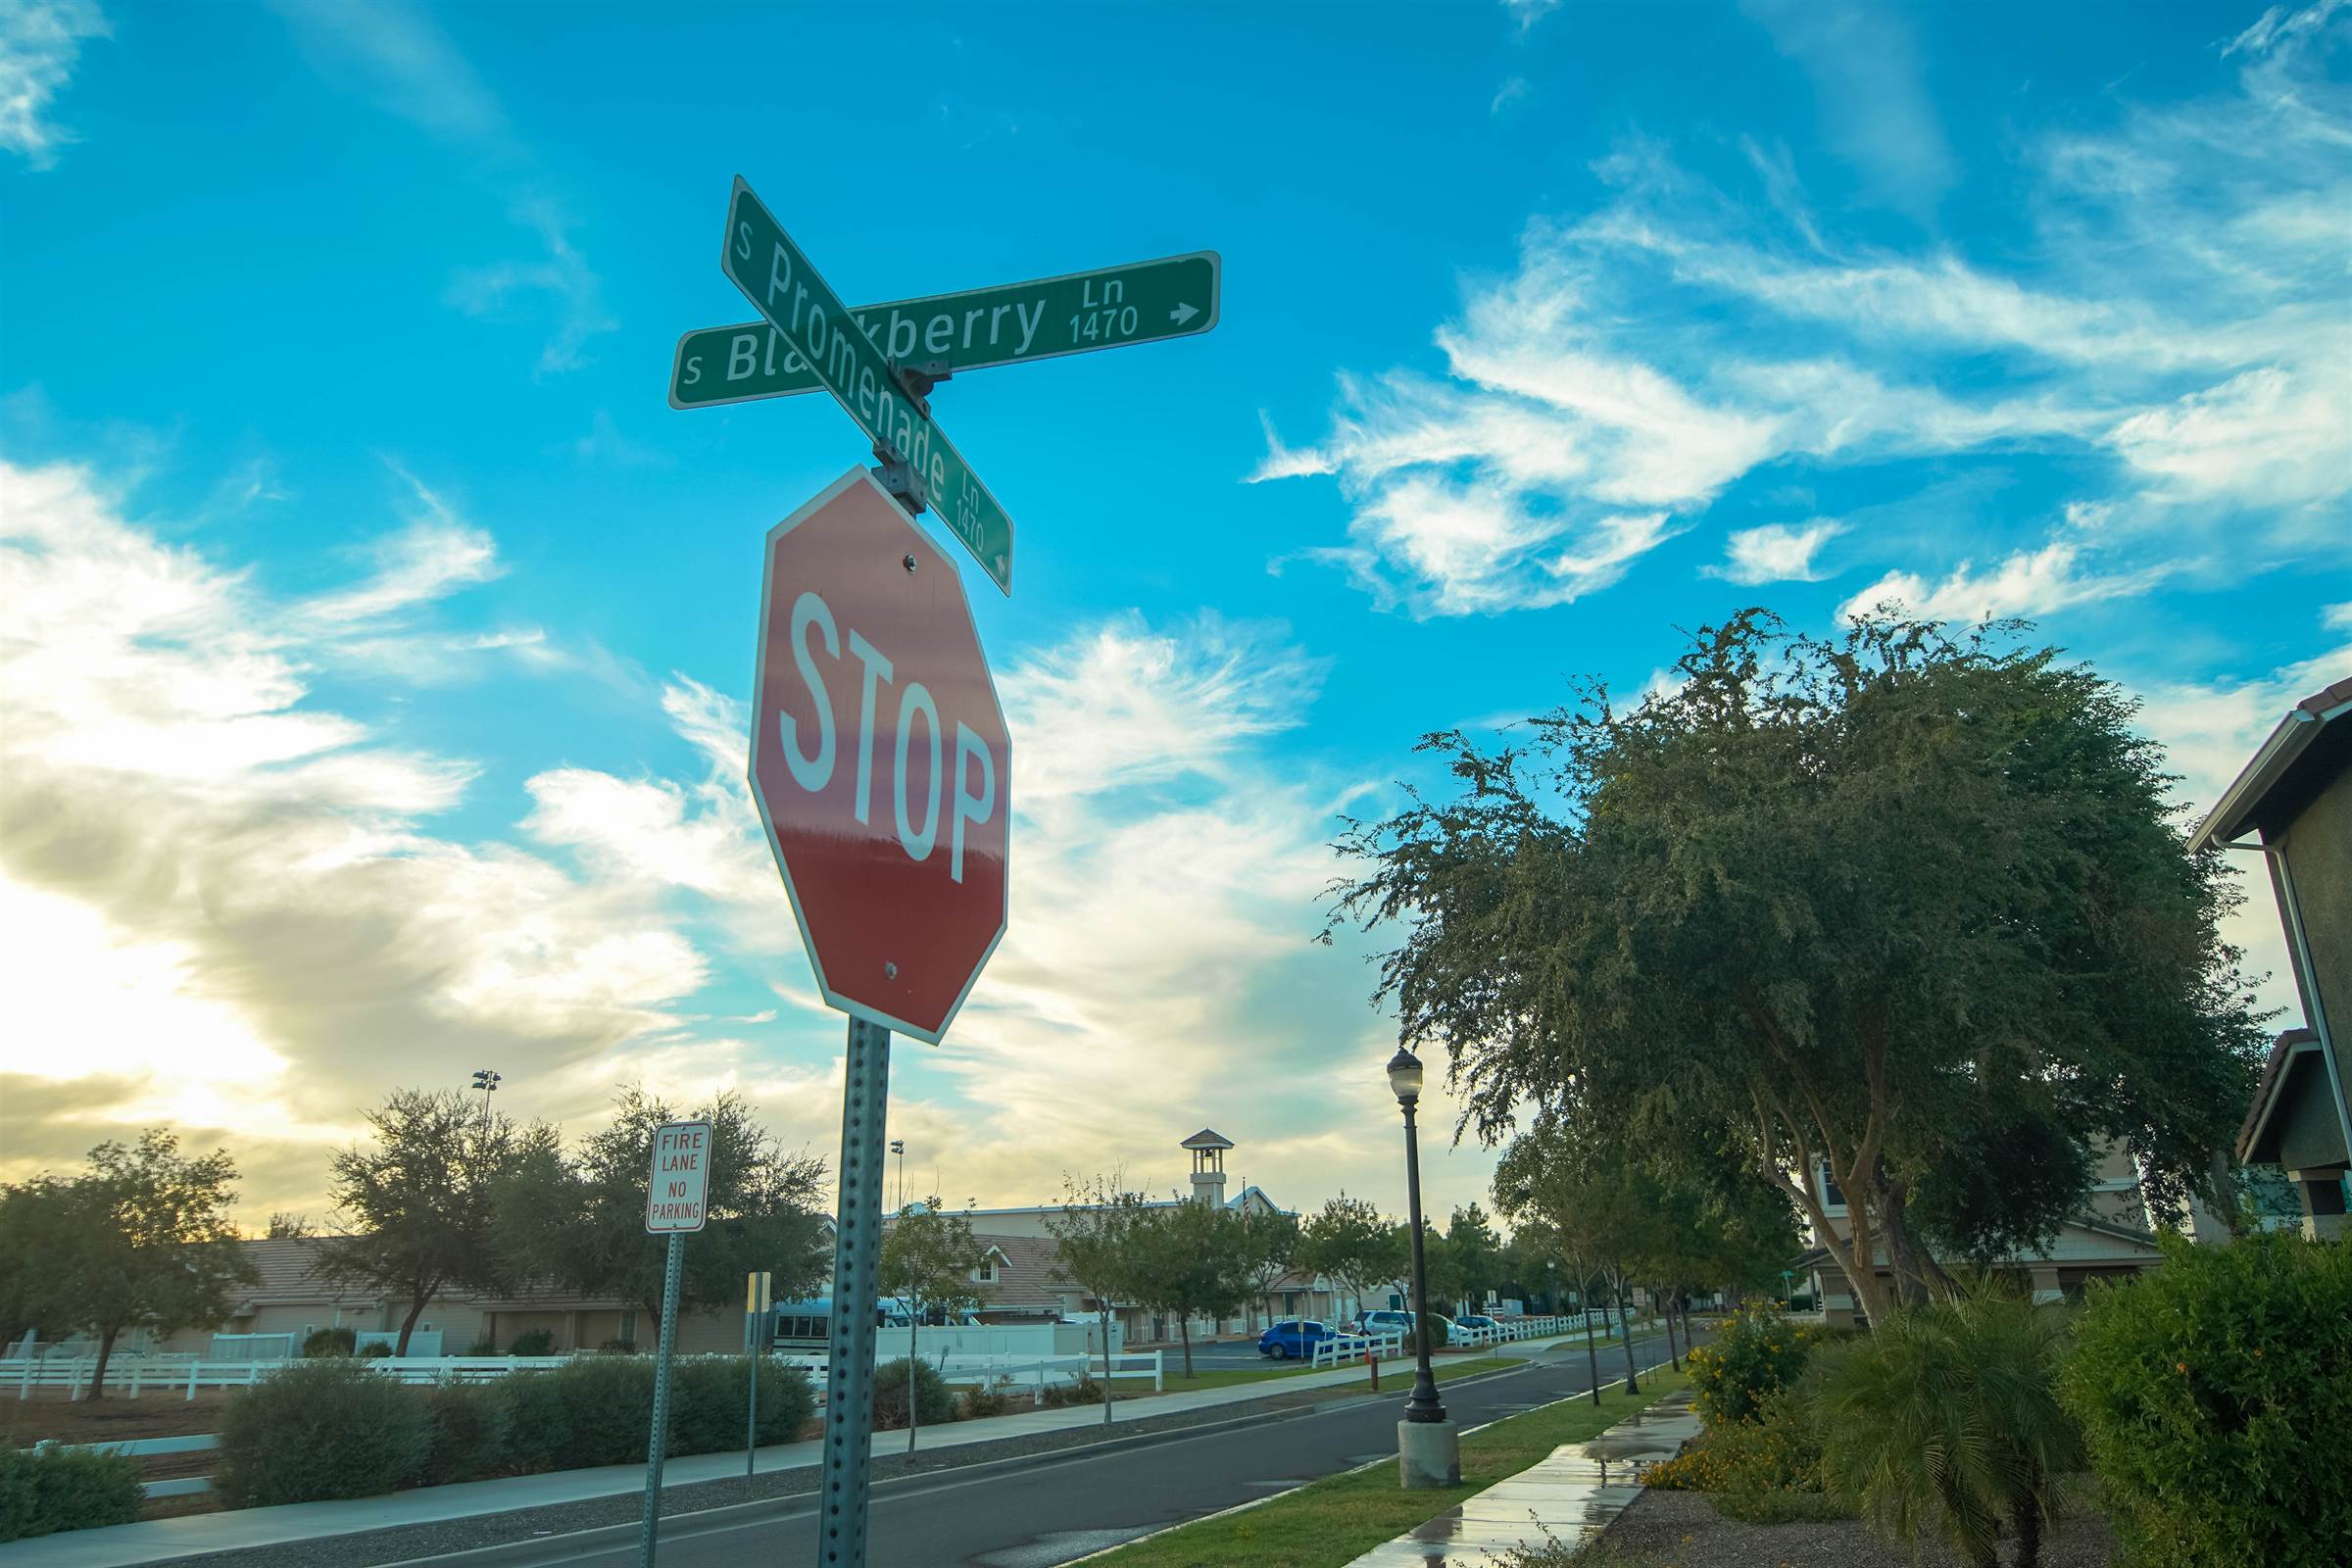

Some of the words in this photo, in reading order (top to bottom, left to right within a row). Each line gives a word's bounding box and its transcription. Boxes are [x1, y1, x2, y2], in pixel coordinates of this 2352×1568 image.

[1083, 277, 1124, 309] Ln
[727, 298, 1046, 381] Blaberry
[1069, 306, 1139, 342] 1470
[768, 242, 945, 502] Promenade
[962, 470, 979, 514] Ln
[956, 499, 984, 552] 1470
[780, 591, 997, 885] STOP
[662, 1133, 703, 1151] FIRE
[662, 1154, 699, 1171] LANE
[668, 1181, 686, 1198] NO
[653, 1202, 700, 1219] PARKING
